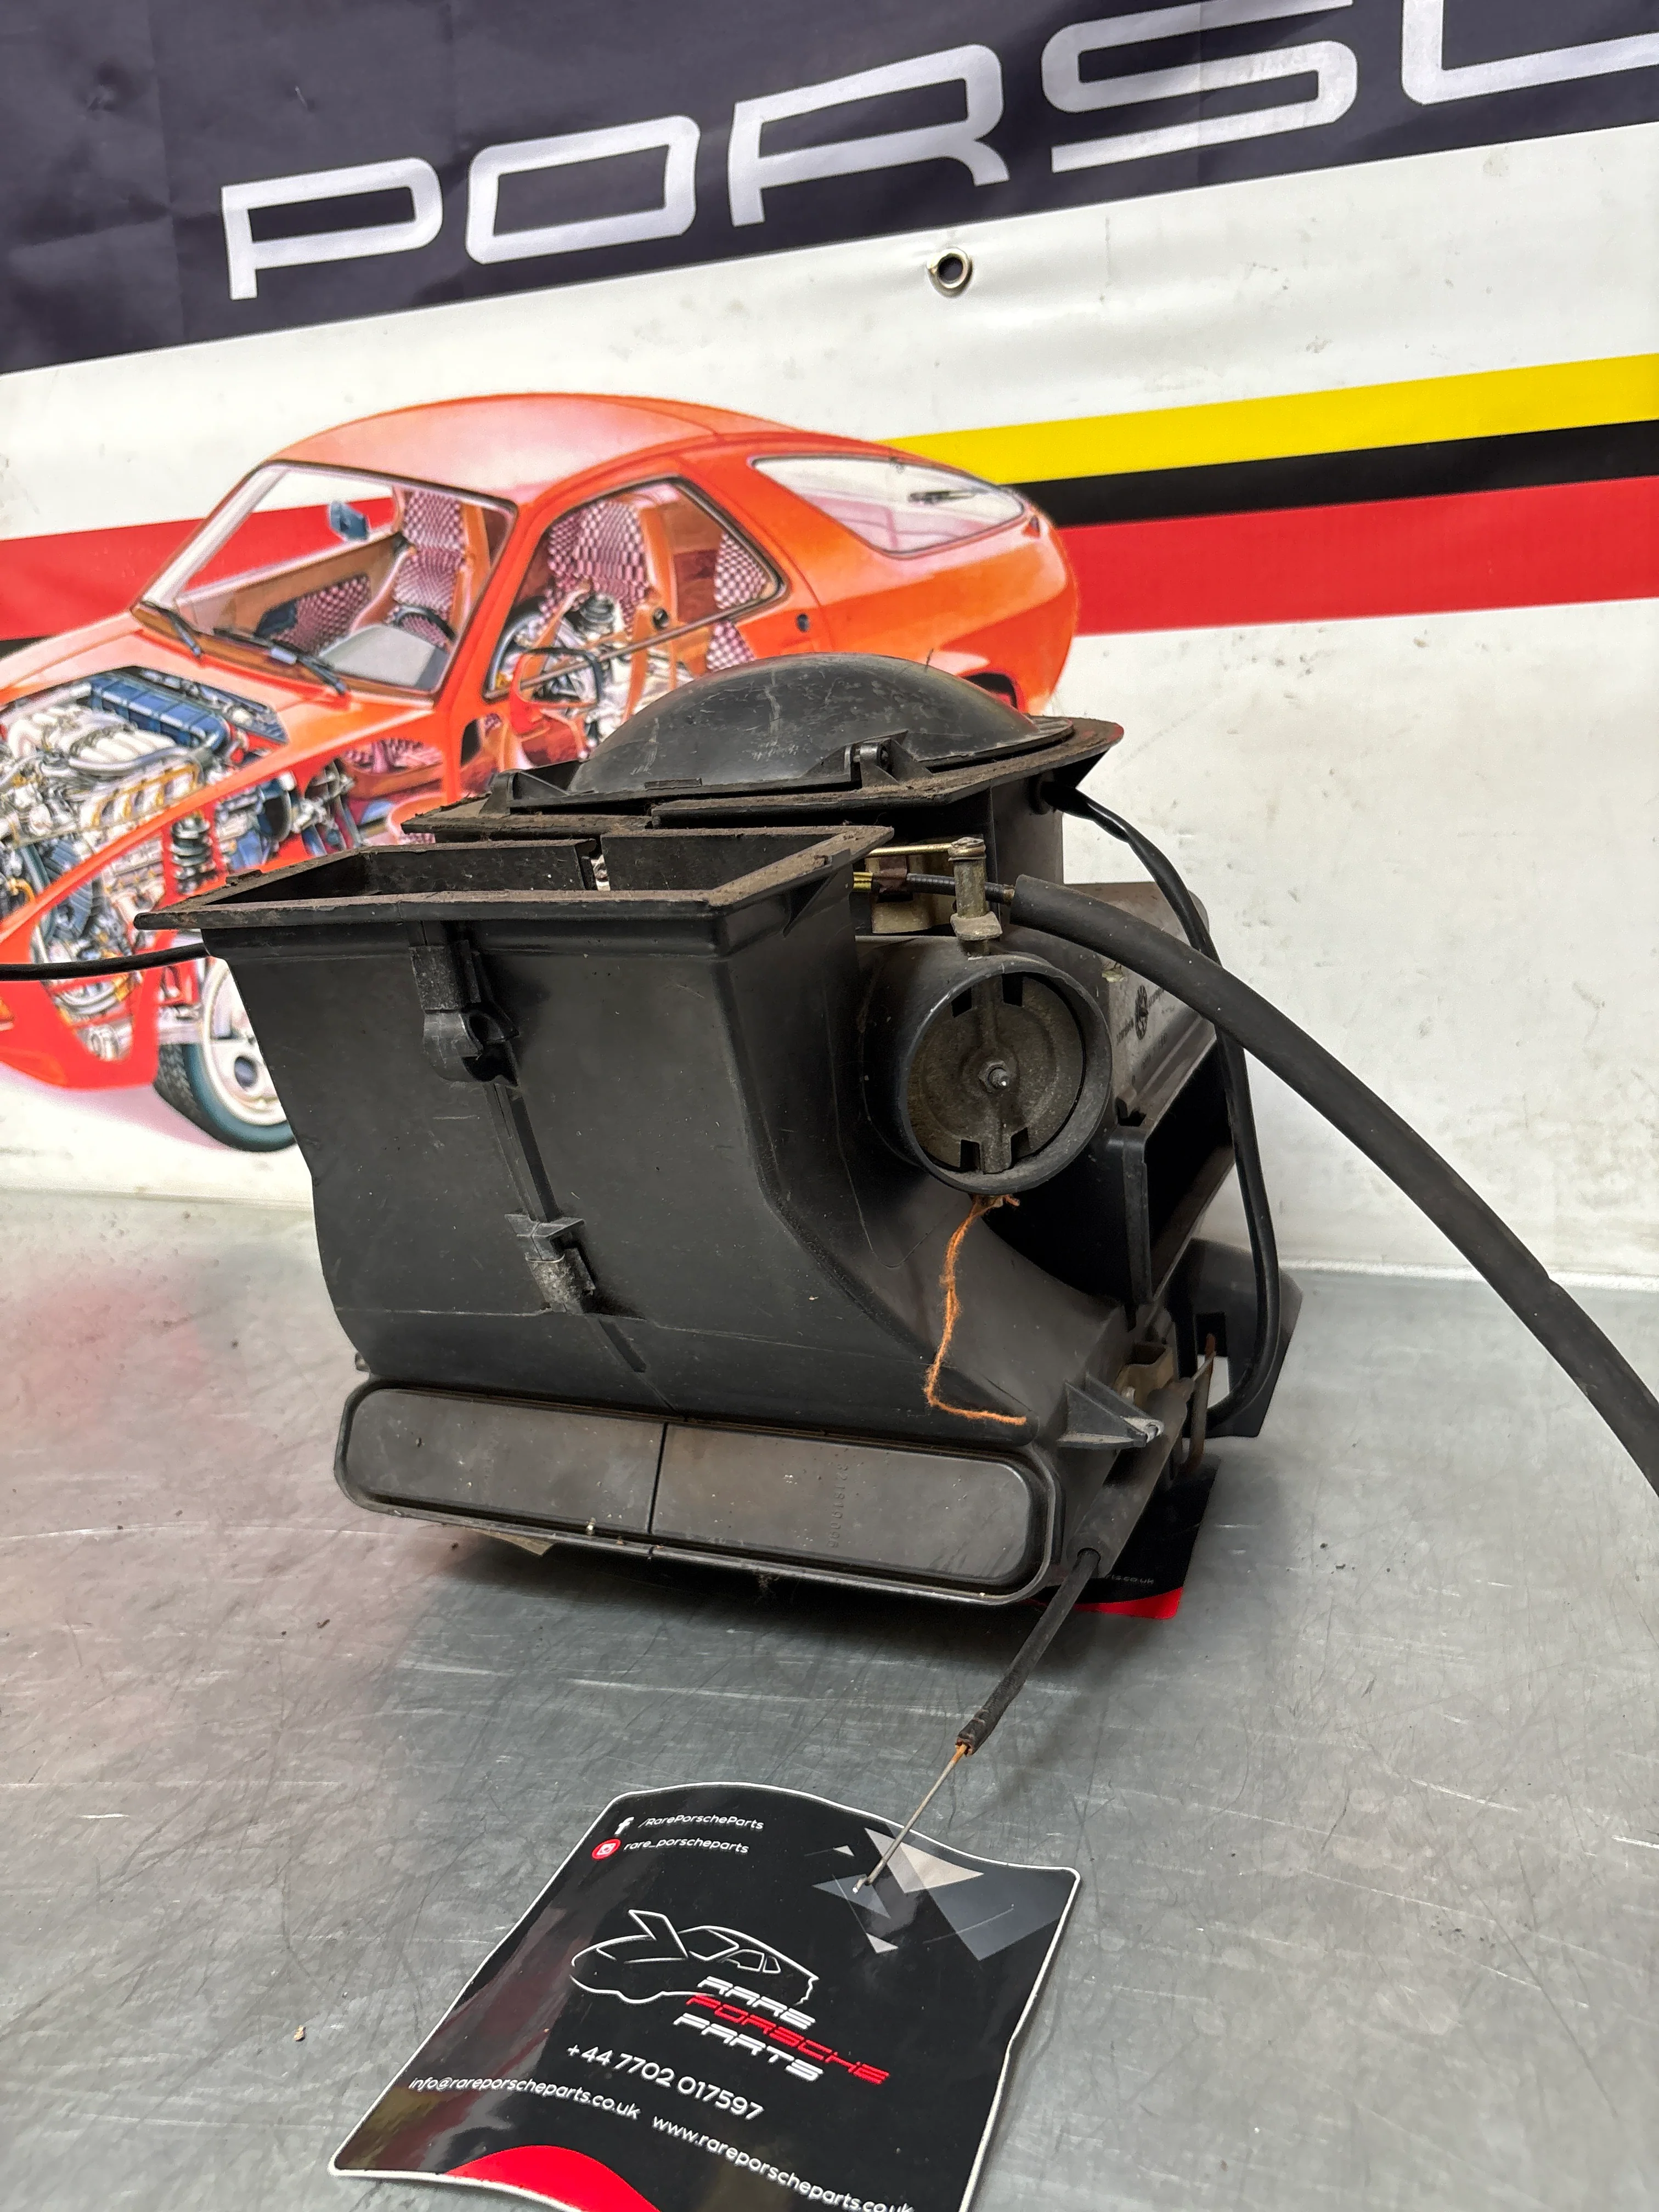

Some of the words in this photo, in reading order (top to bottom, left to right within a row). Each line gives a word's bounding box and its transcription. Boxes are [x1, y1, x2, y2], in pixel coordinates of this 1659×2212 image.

[623, 1837, 750, 1854] rare_porscheparts
[637, 1814, 765, 1830] /RarePorscheParts
[697, 1976, 816, 2030] RARE
[673, 2012, 824, 2082] PARTS
[685, 1994, 890, 2085] PORSCHE
[567, 2044, 613, 2067] +44
[614, 2053, 675, 2088] 7702
[677, 2075, 764, 2120] 017597
[409, 2076, 641, 2120] info@rareporscheparts.co.uk
[652, 2115, 915, 2212] www.rareporscheparts.couk
